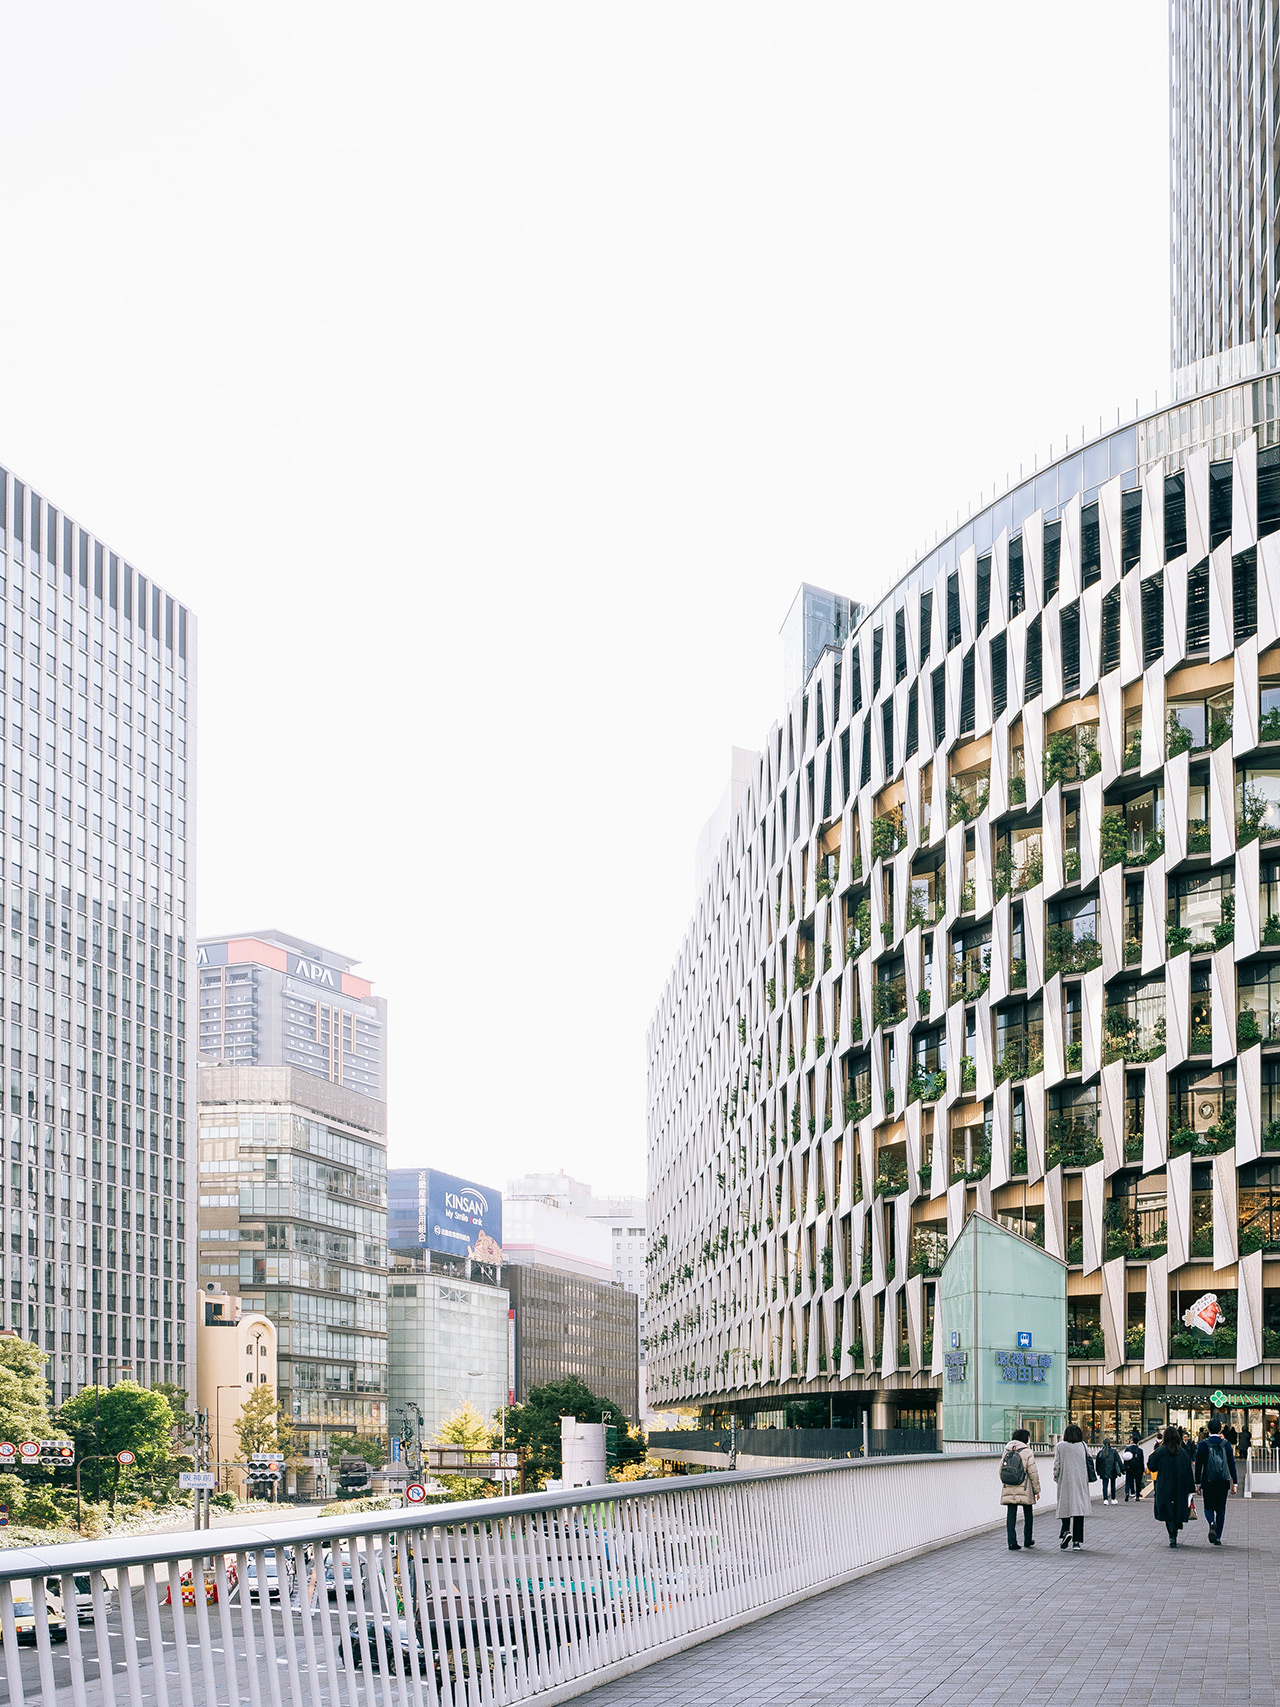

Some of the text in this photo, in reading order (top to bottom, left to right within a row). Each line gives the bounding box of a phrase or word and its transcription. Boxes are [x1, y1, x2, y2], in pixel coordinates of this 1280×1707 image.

[295, 959, 334, 986] APA
[445, 1191, 483, 1217] KINSAN
[454, 1211, 469, 1223] Smile
[995, 1351, 1052, 1368] 阪神電車
[1002, 1366, 1046, 1382] 梅田駅
[24, 1445, 36, 1454] 50
[121, 1452, 131, 1462] 50
[182, 1474, 212, 1482] 阪神前
